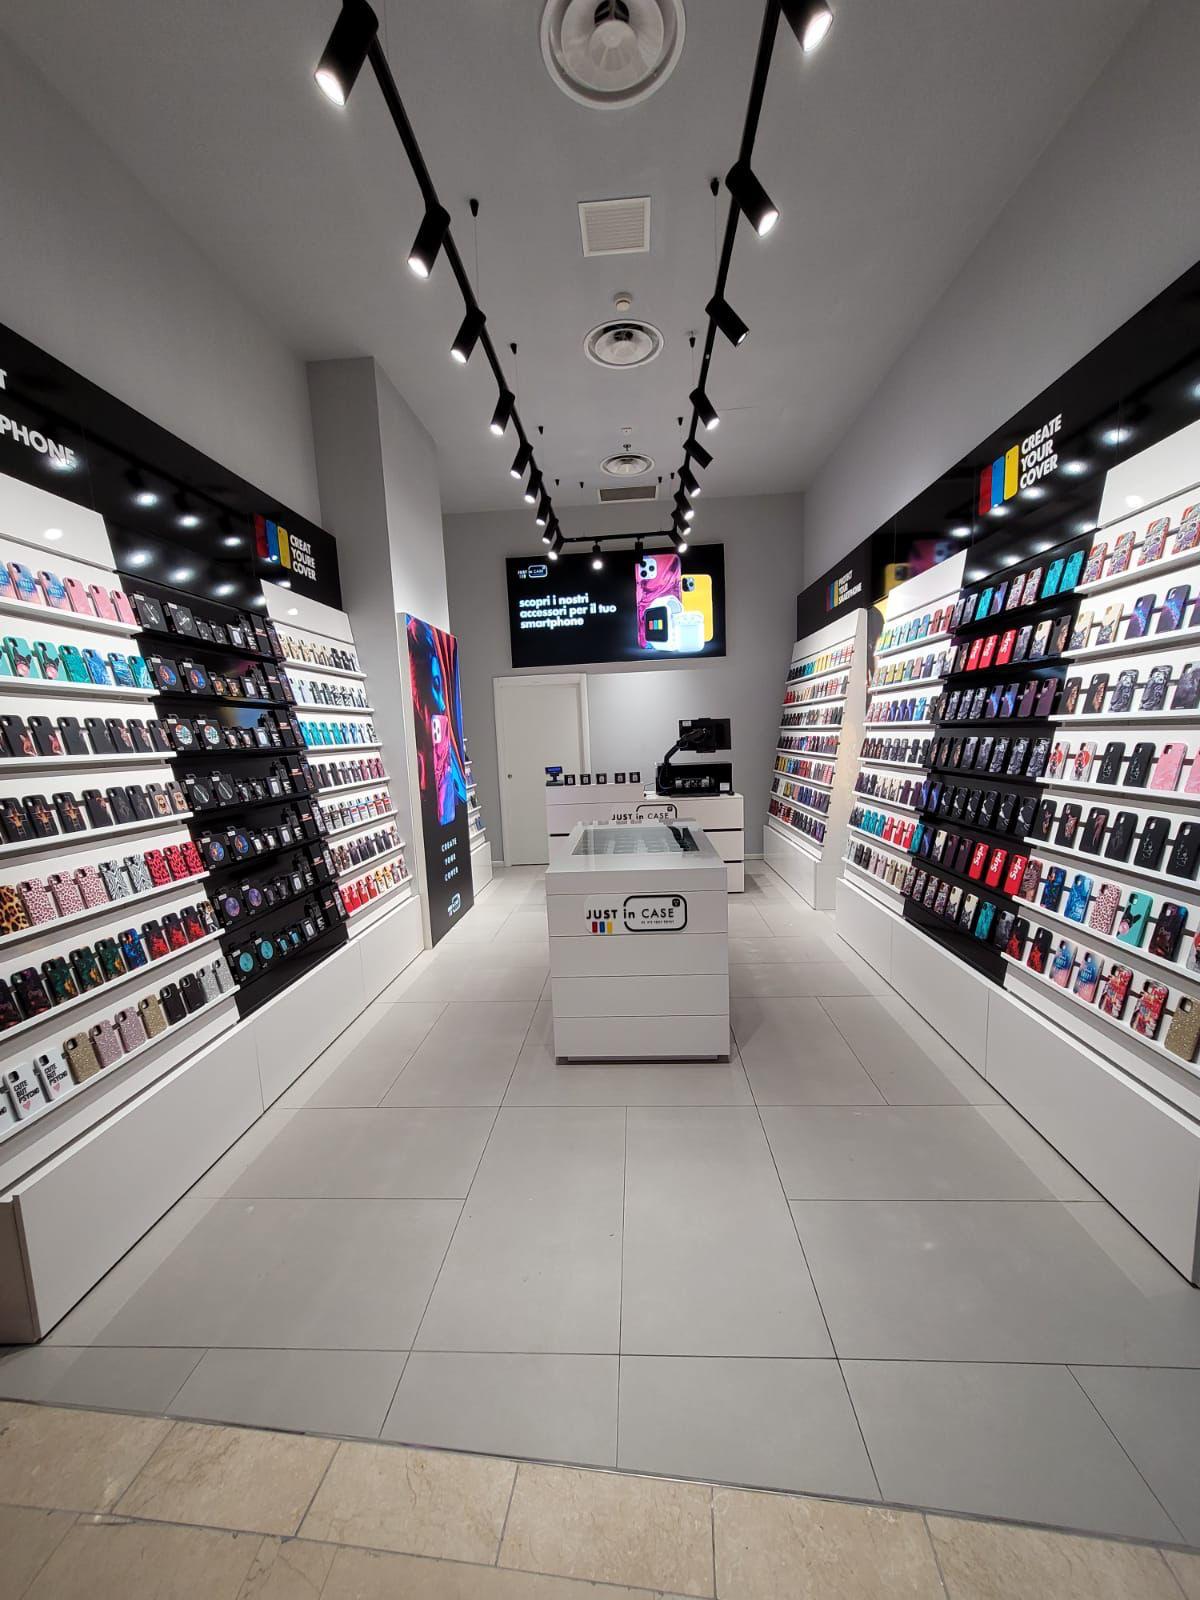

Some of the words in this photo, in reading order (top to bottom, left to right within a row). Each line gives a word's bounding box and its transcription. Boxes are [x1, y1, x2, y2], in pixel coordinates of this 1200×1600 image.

[1021, 413, 1062, 455] CREATE
[1020, 439, 1054, 472] YOUR
[1020, 453, 1058, 489] COVER
[292, 560, 317, 581] COVER
[519, 595, 551, 609] scopri
[552, 594, 557, 605] i
[558, 592, 589, 605] nostri
[520, 605, 567, 618] accessori
[569, 605, 588, 618] per
[589, 603, 597, 614] il
[598, 604, 617, 613] tuo
[520, 616, 584, 630] smartphone
[611, 813, 633, 821] JUST
[636, 812, 644, 820] in
[647, 812, 670, 820] CASE
[586, 909, 618, 920] JUST
[623, 908, 636, 919] in
[641, 907, 675, 919] CASE
[44, 1062, 57, 1074] CUTE
[46, 1070, 57, 1081] BUT
[48, 1070, 68, 1086] PSYCHO
[13, 1080, 29, 1092] CUTE
[16, 1088, 27, 1098] BUT
[19, 1087, 40, 1104] PSYCHO
